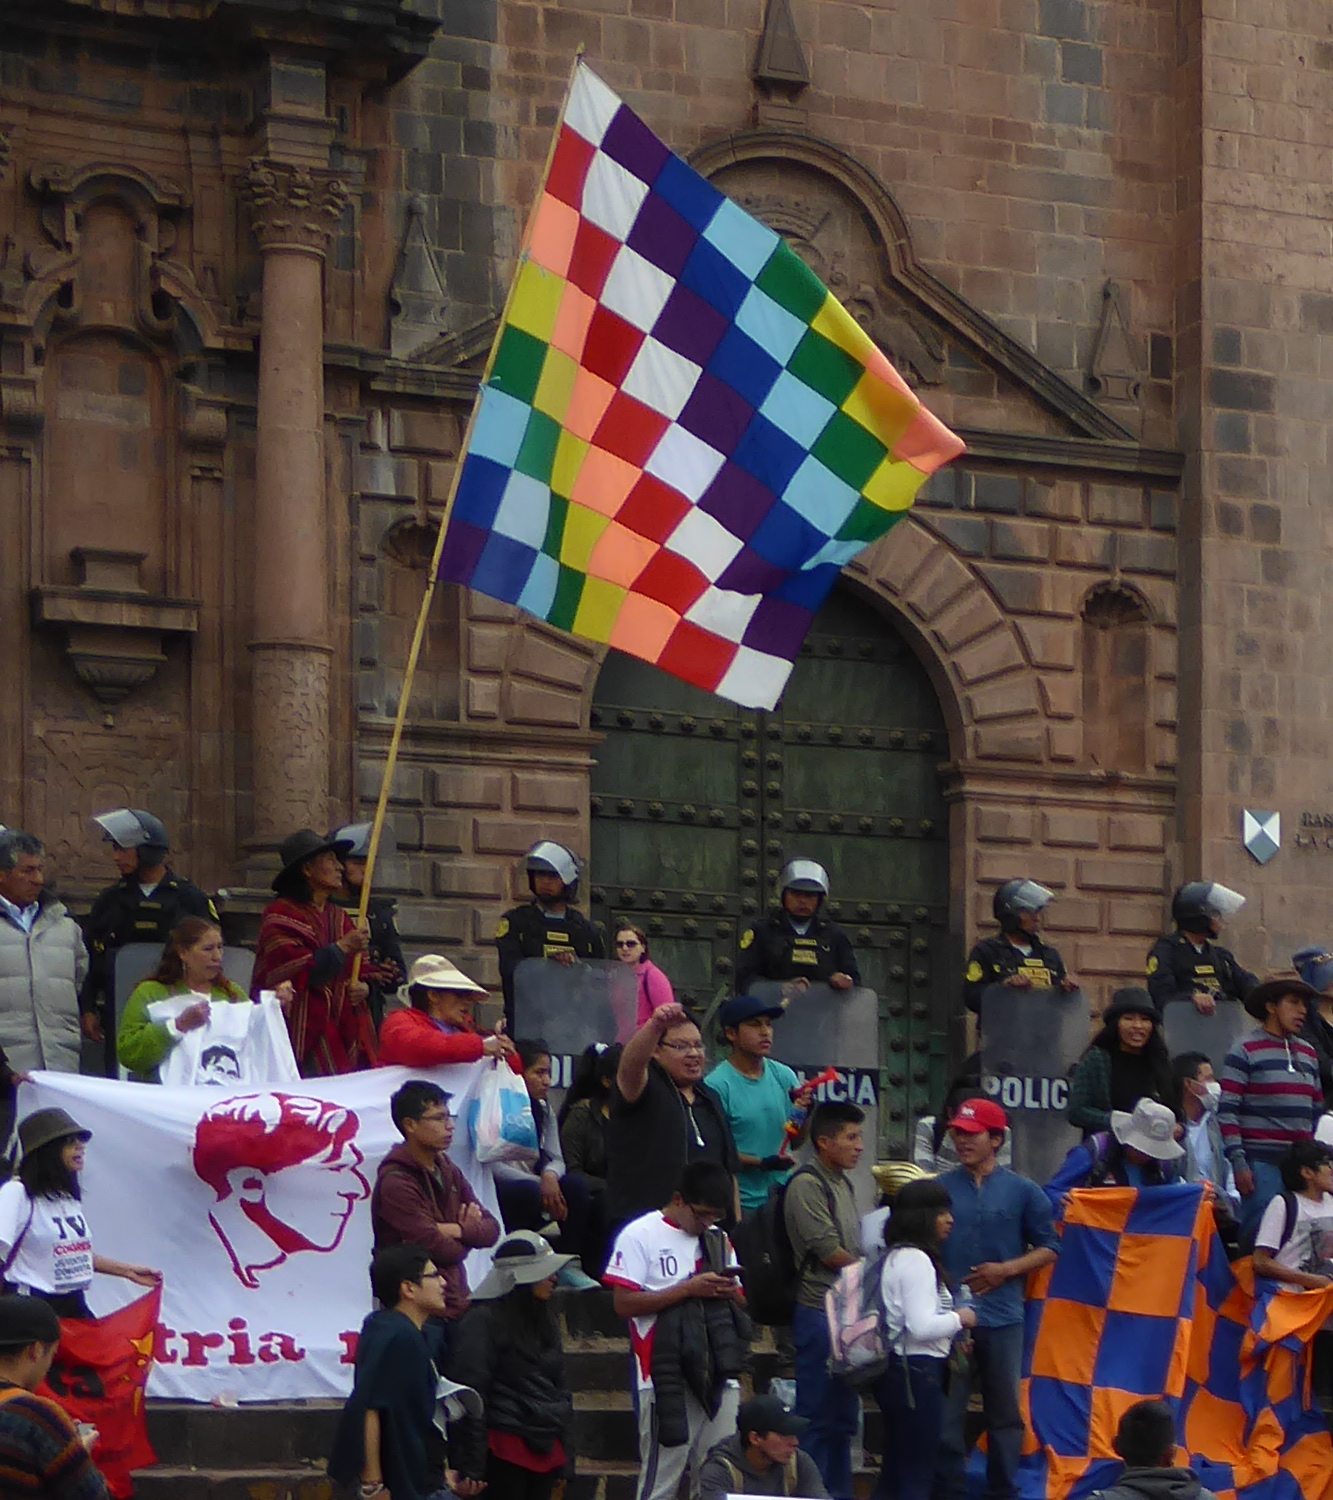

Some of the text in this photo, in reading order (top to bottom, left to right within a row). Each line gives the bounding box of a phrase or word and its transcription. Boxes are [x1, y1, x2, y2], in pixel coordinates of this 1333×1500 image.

[1294, 833, 1319, 851] LA
[52, 1215, 86, 1239] IV
[659, 1255, 678, 1278] 10
